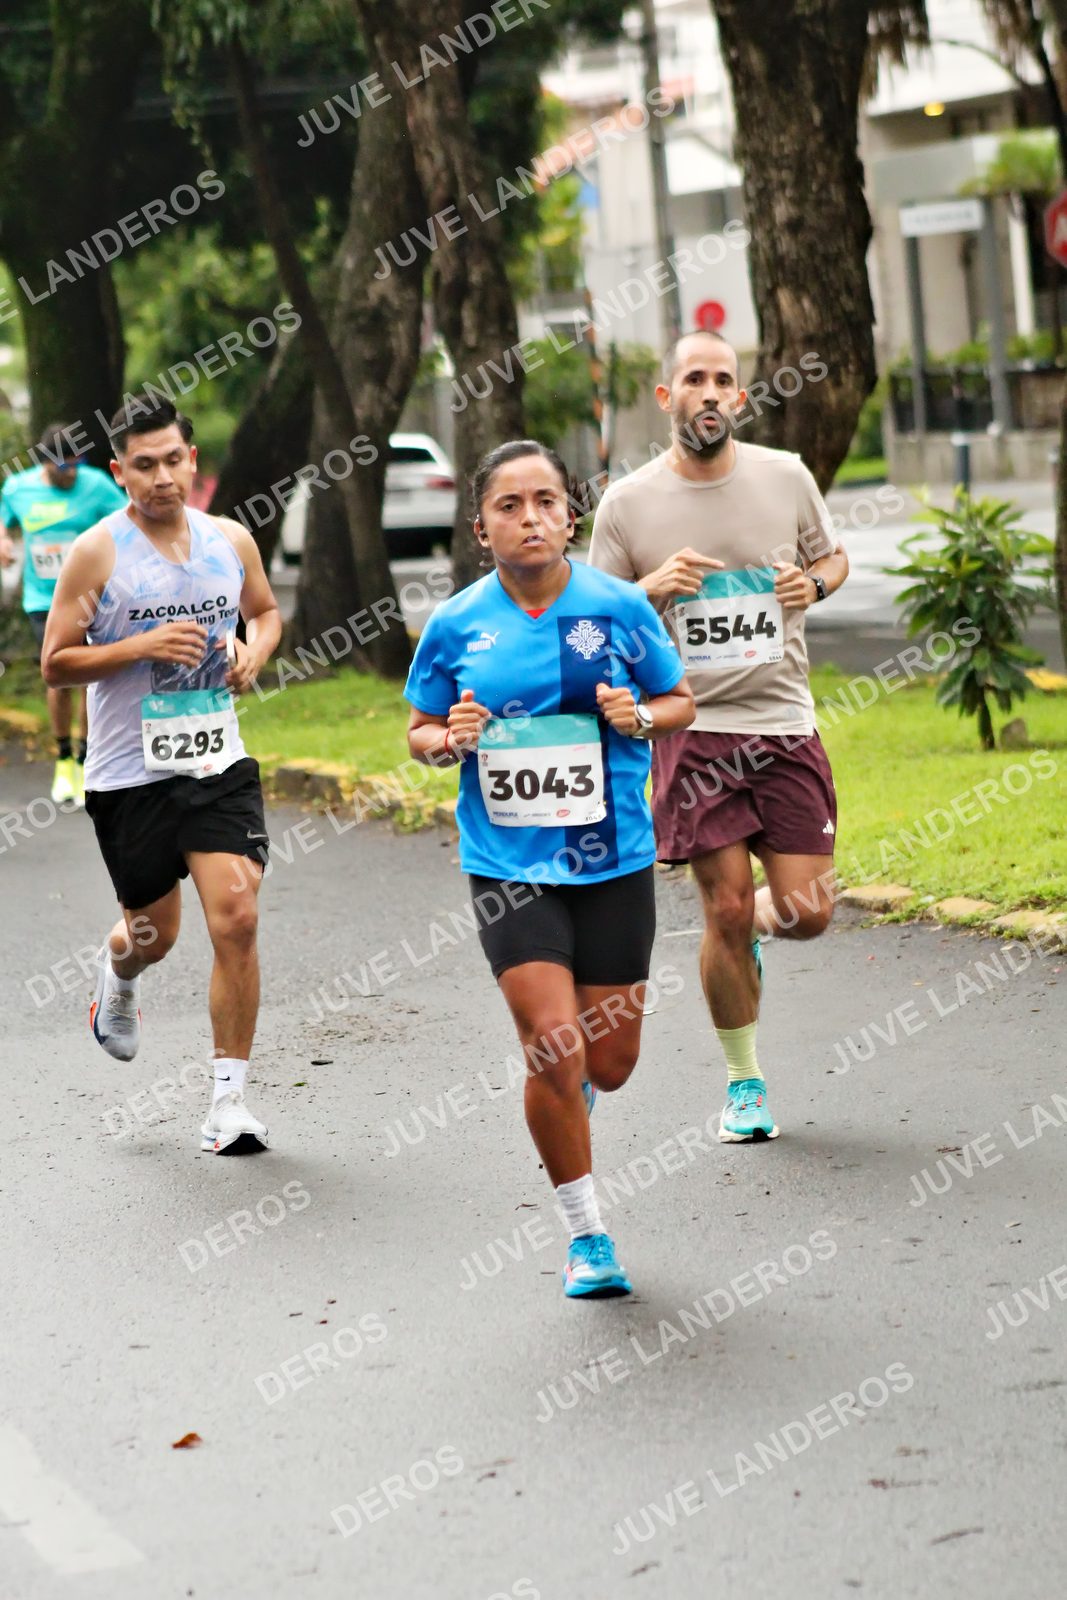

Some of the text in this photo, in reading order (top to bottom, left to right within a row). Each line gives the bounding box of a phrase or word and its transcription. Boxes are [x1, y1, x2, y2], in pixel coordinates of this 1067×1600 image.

[685, 611, 777, 647] 5544
[151, 727, 224, 761] 6293
[487, 764, 595, 801] 3043
